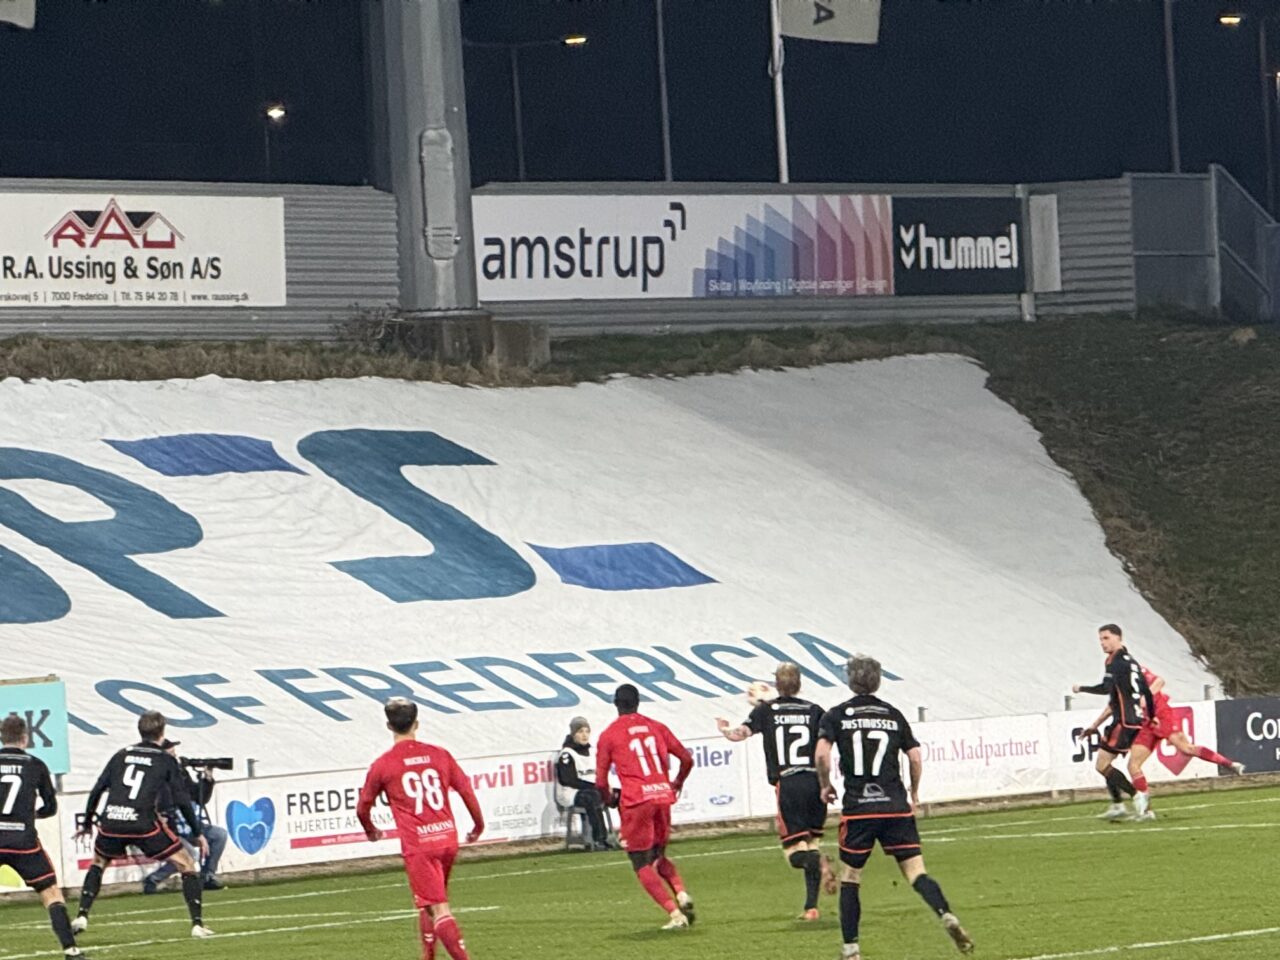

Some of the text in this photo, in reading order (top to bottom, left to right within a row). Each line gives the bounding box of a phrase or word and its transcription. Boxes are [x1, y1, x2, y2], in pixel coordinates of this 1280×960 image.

[482, 227, 665, 291] amstrup
[918, 222, 1019, 270] hummel
[2, 254, 222, 284] R.A. Ussing & Søn A/S
[95, 632, 905, 729] OF FREDERICIA
[773, 714, 811, 725] SCHMIDT
[628, 735, 664, 777] 11
[686, 745, 734, 768] iler
[775, 725, 810, 766] 12
[852, 730, 889, 777] 17
[948, 736, 1040, 766] Madpartner
[122, 764, 145, 799] 4
[402, 767, 444, 815] 98
[522, 760, 553, 785] Bil
